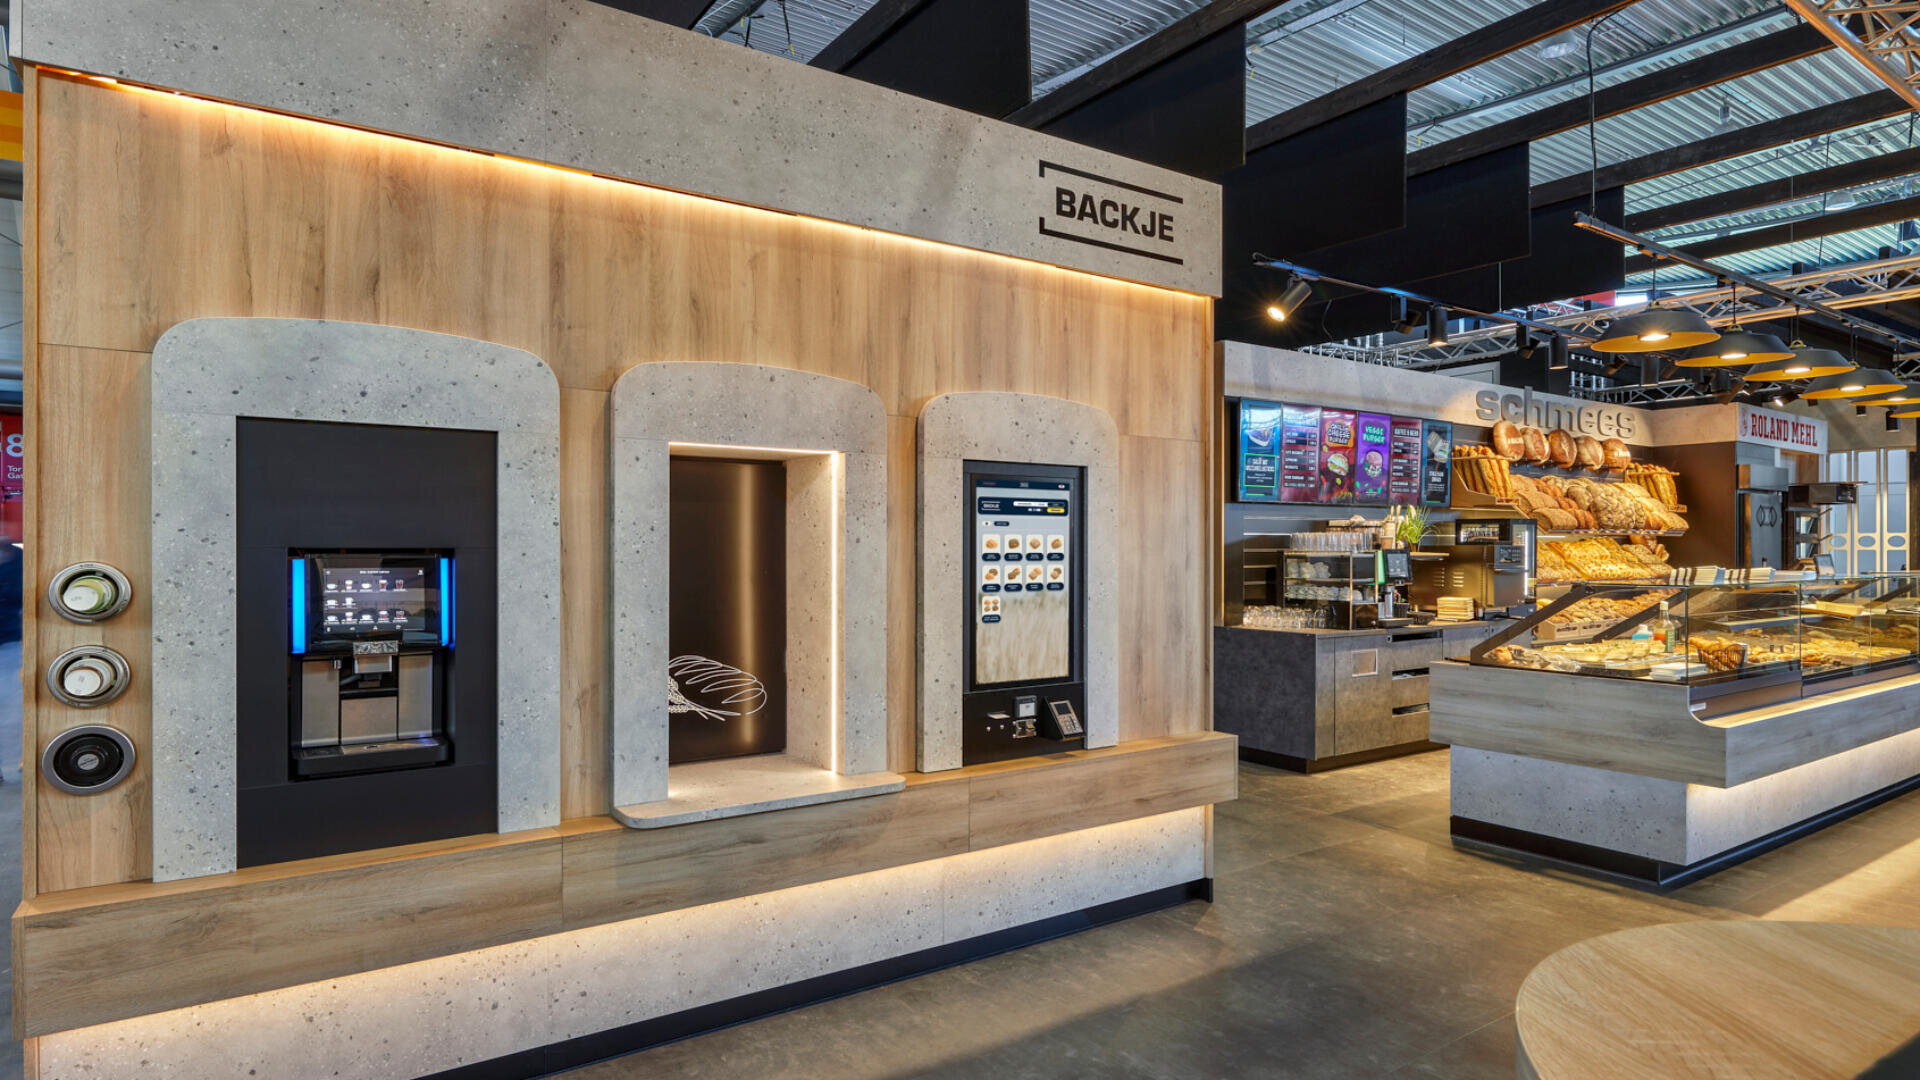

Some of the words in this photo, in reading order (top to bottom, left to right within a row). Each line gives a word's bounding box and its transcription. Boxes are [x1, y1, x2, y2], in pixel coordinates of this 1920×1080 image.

[1055, 186, 1174, 243] BACKJE
[1475, 385, 1637, 439] schmees
[1751, 413, 1790, 442] ROLAND
[1791, 421, 1818, 447] MEHL
